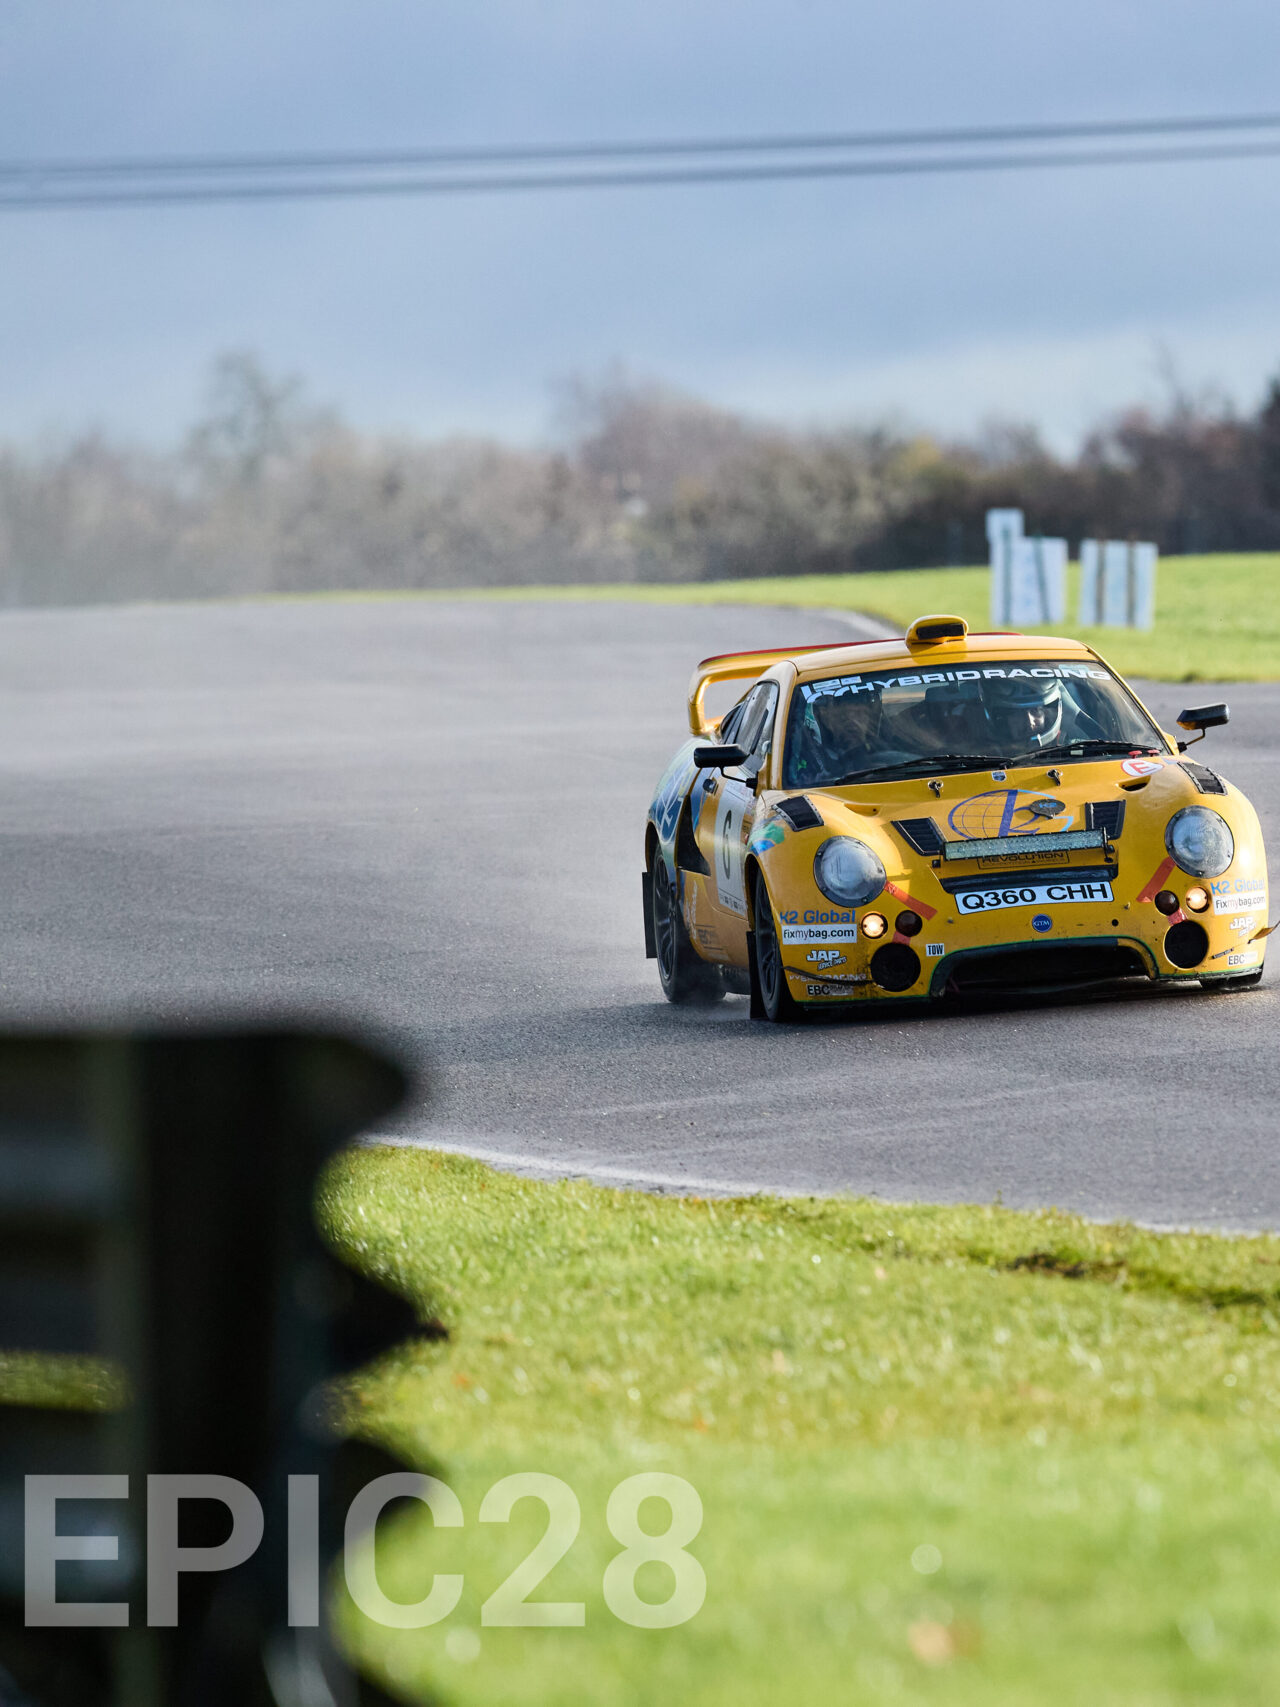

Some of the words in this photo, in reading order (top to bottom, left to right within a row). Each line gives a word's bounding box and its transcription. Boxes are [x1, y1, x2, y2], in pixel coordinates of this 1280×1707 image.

[1210, 880, 1231, 895] K2
[962, 888, 1037, 910] Q360
[1046, 883, 1108, 901] CHH
[780, 910, 799, 924] K2
[803, 909, 856, 924] Global
[806, 950, 840, 962] JAP
[927, 945, 943, 955] TOW
[1228, 954, 1245, 965] EBC
[807, 984, 830, 995] EBC
